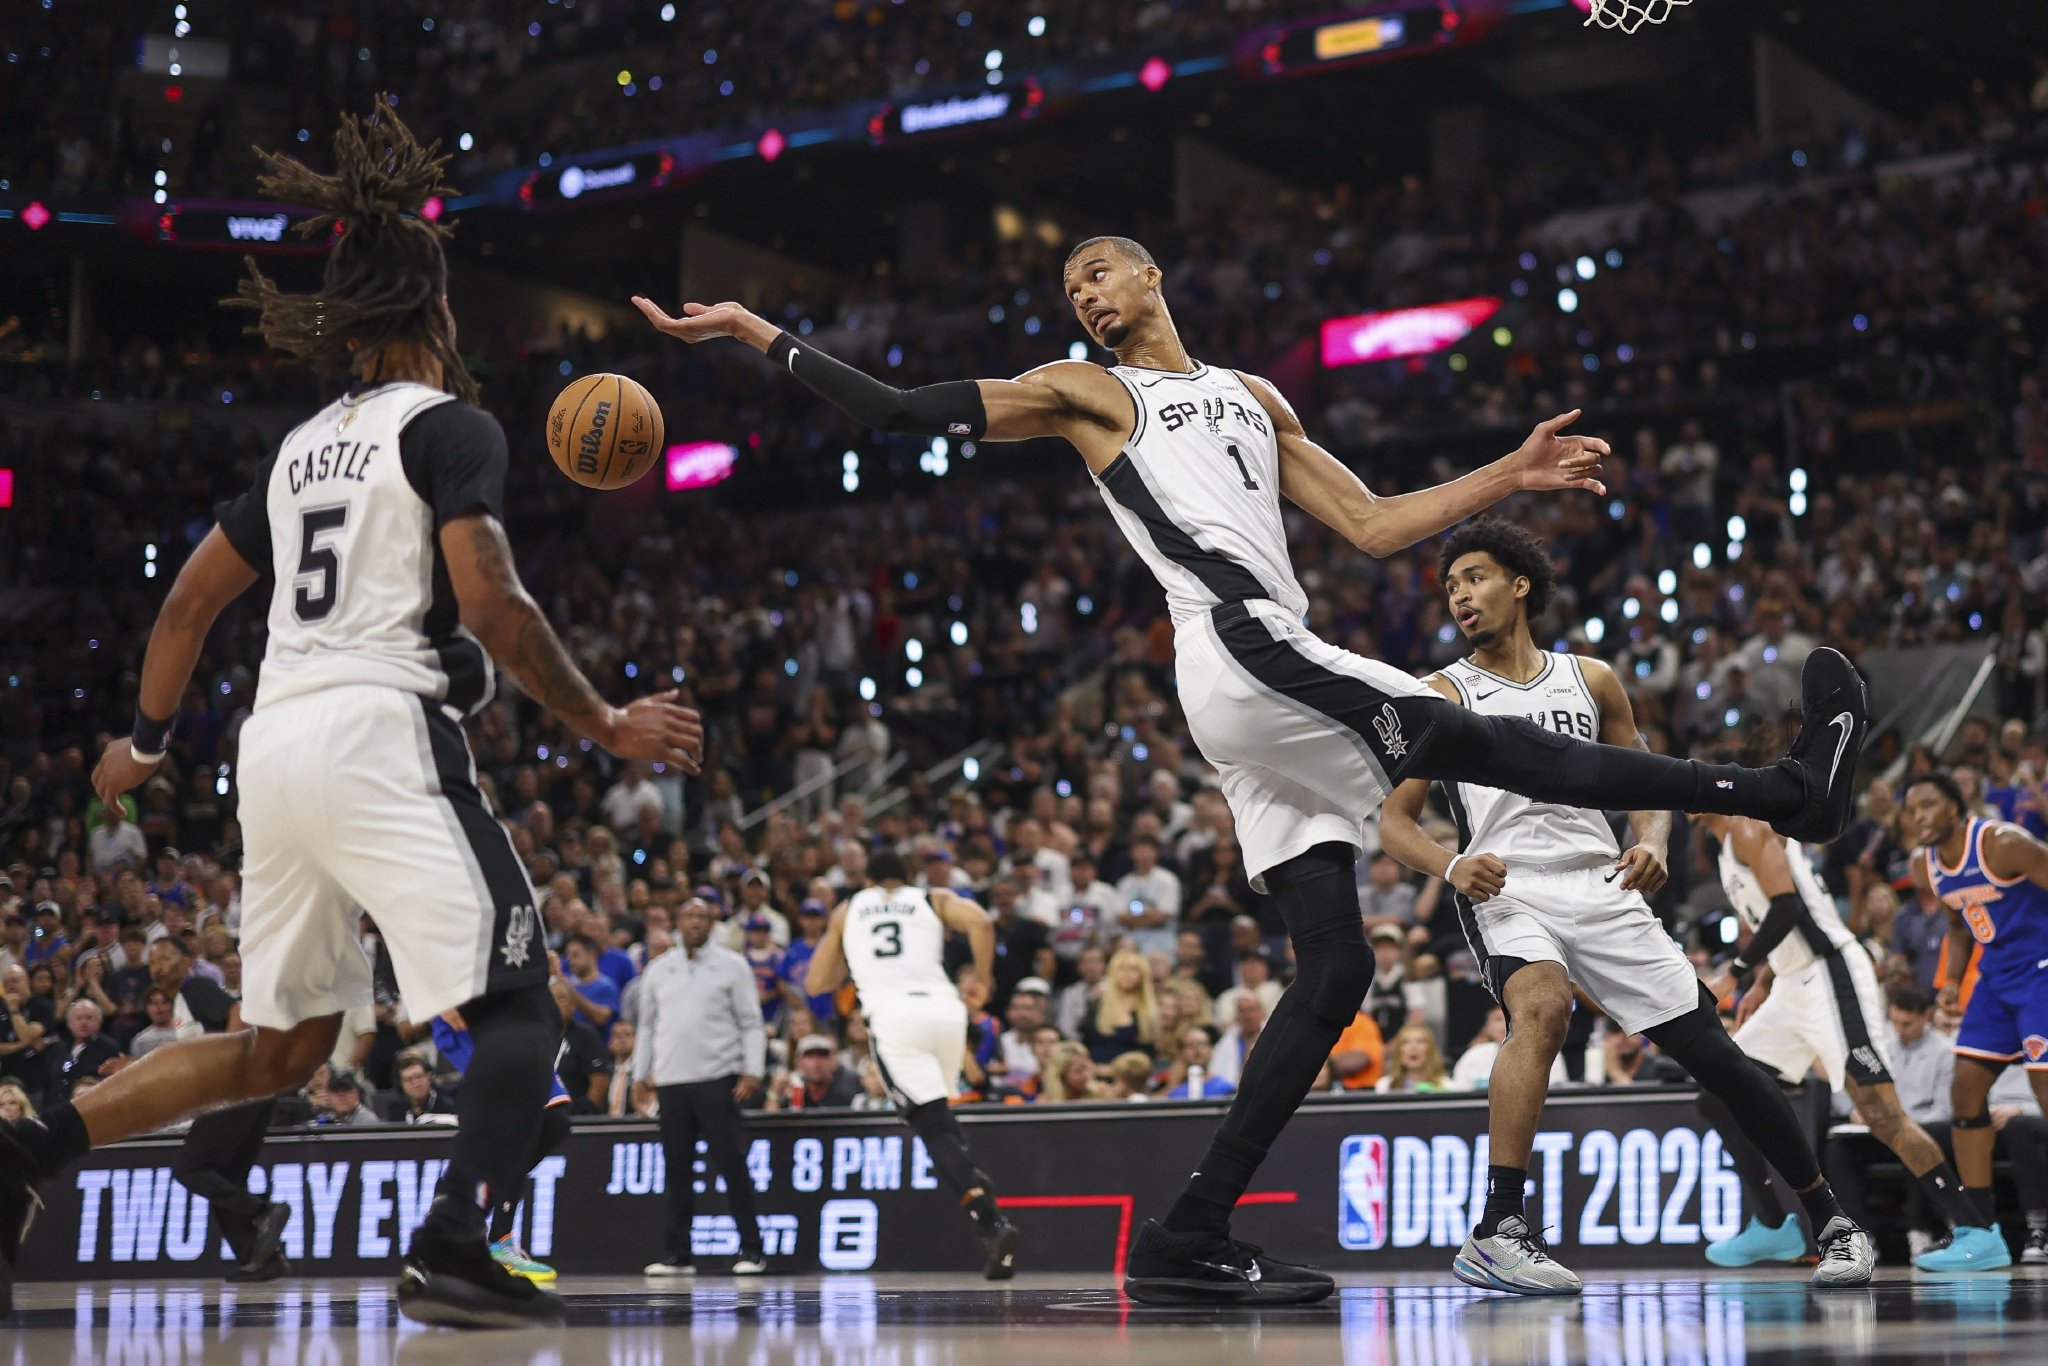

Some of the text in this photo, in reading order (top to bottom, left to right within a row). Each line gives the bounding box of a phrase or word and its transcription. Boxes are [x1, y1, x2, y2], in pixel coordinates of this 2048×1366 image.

[577, 401, 612, 475] Wilson
[289, 441, 379, 495] CASTLE
[1227, 444, 1260, 490] 1
[292, 501, 350, 627] 5
[872, 921, 902, 957] 3
[1962, 904, 1996, 943] 8
[792, 1138, 824, 1191] 8
[832, 1136, 903, 1191] PM
[1579, 1126, 1743, 1246] 2026
[356, 1155, 567, 1259] EVT
